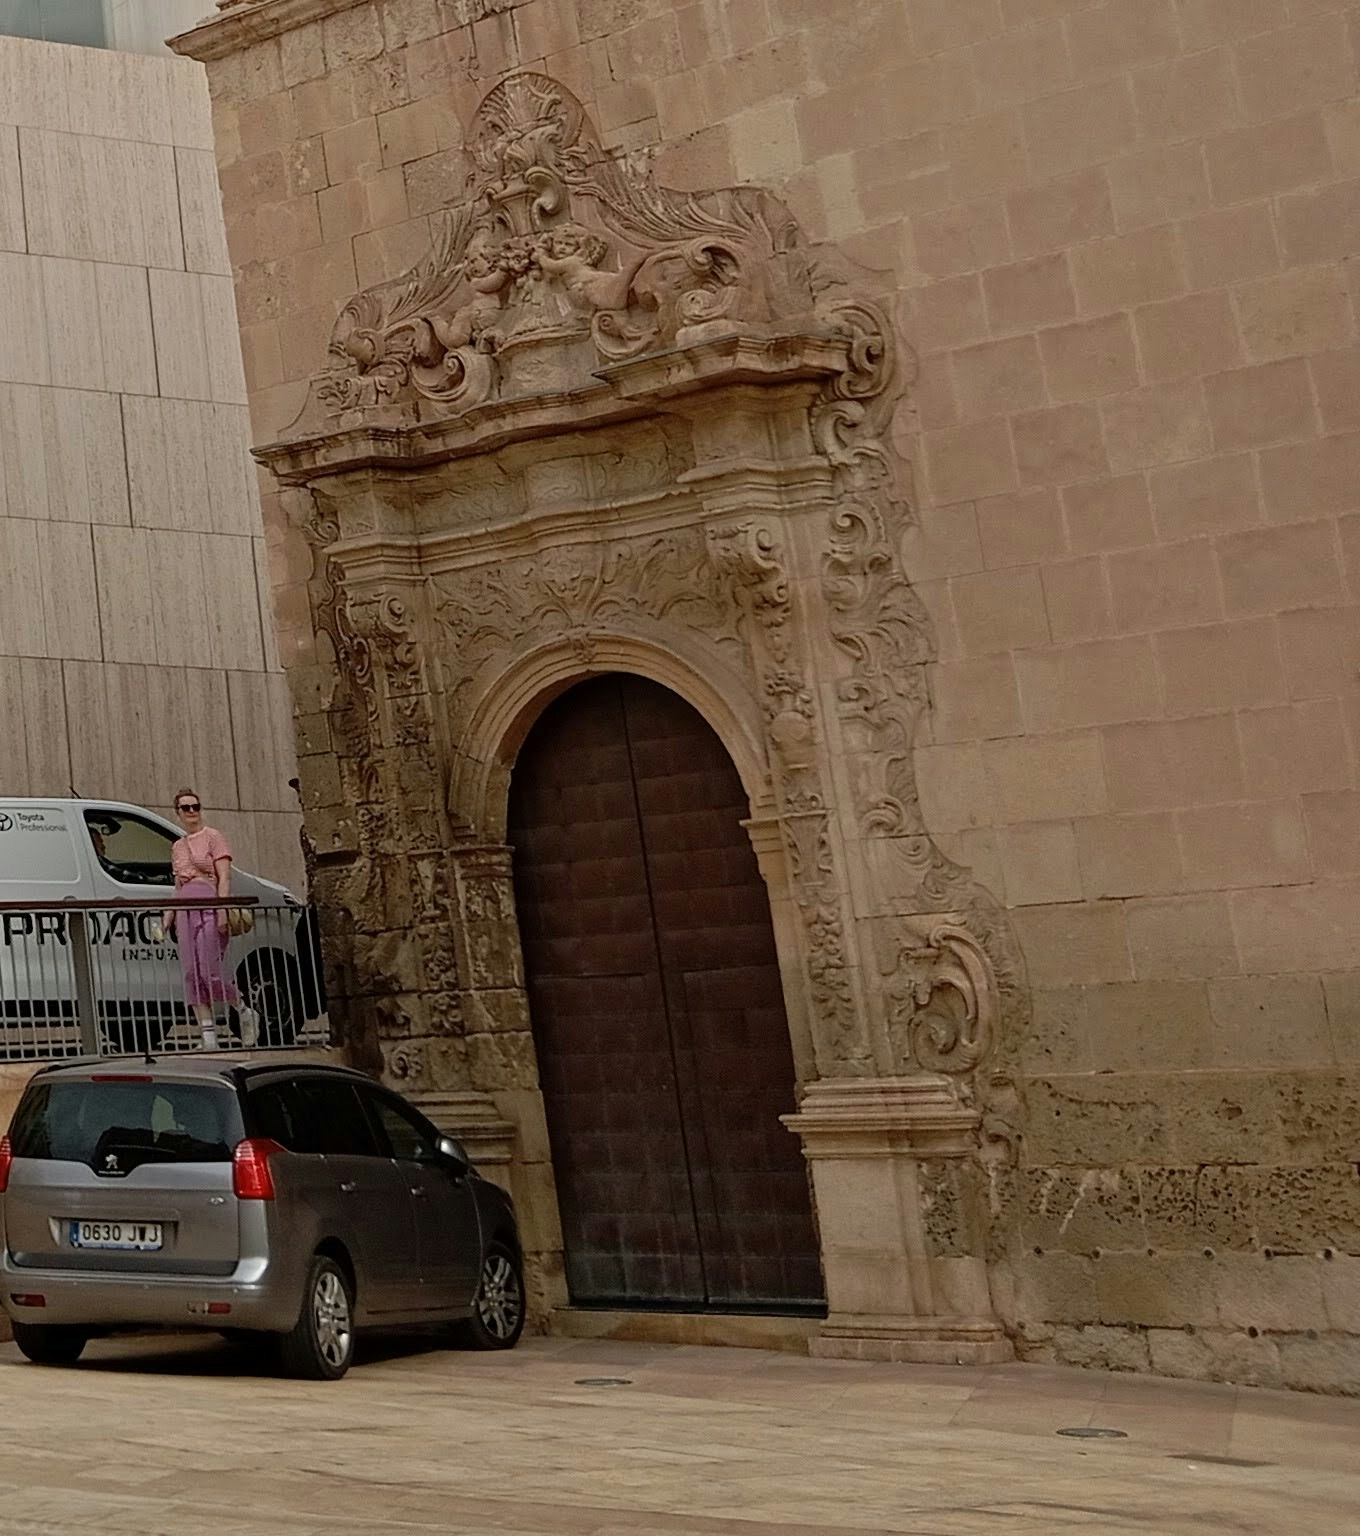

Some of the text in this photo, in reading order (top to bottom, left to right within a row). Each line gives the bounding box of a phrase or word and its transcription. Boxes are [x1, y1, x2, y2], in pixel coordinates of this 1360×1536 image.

[17, 812, 45, 823] Toyota
[3, 910, 179, 946] PRAC
[83, 1224, 159, 1243] 0630 JWJ
